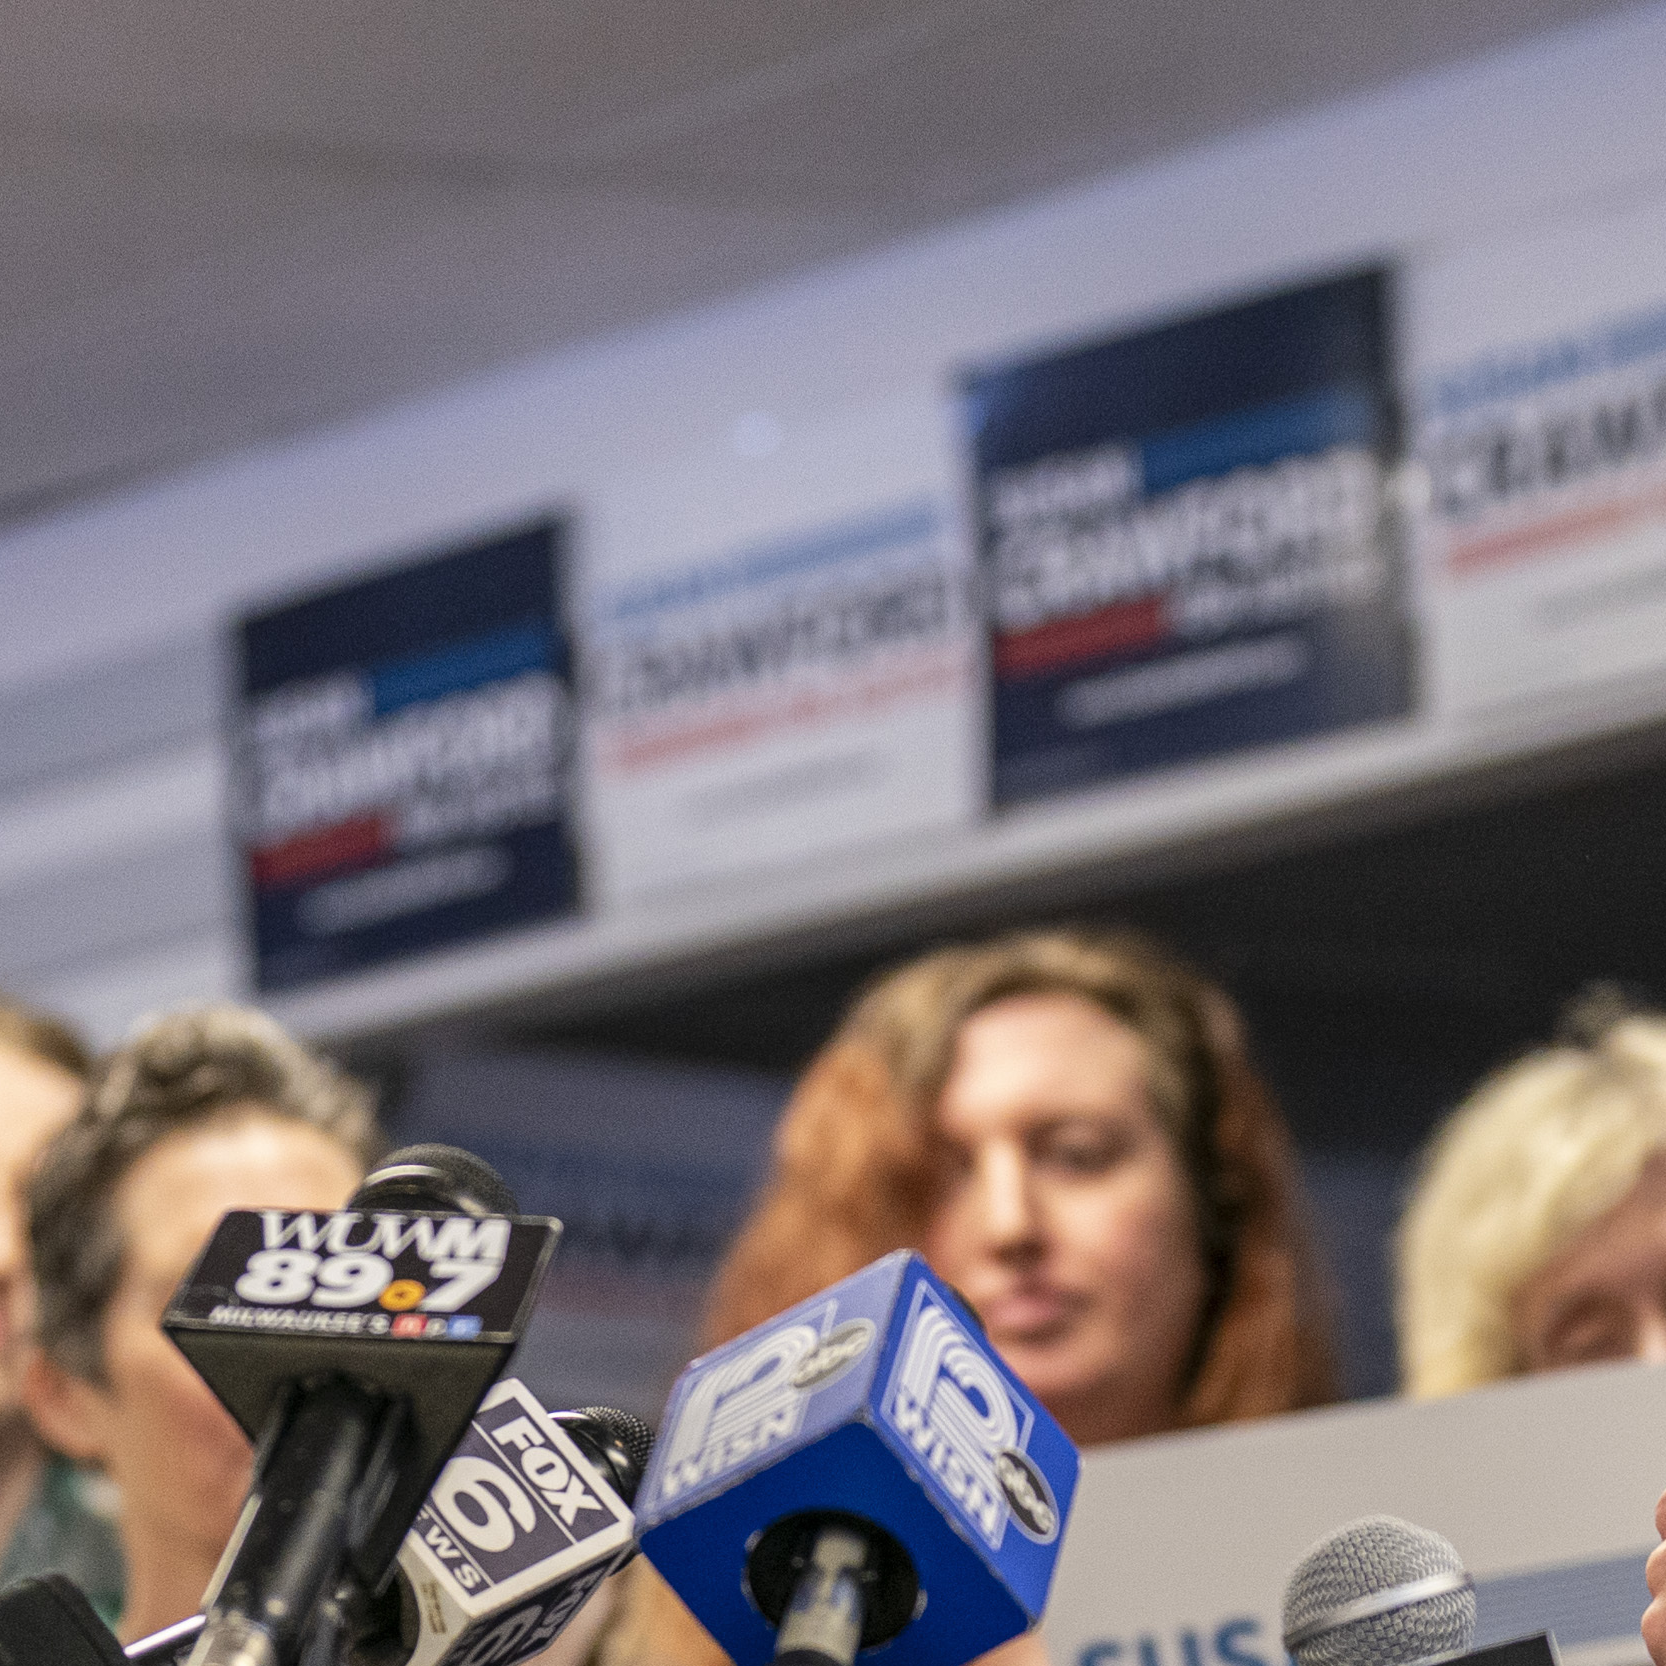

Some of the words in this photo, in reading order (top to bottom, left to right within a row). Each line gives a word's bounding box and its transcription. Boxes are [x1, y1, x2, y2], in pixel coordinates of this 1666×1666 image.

[258, 1211, 513, 1262] WUWM
[234, 1249, 504, 1313] 89.7
[431, 1455, 536, 1553] 6
[491, 1416, 603, 1526] FOX
